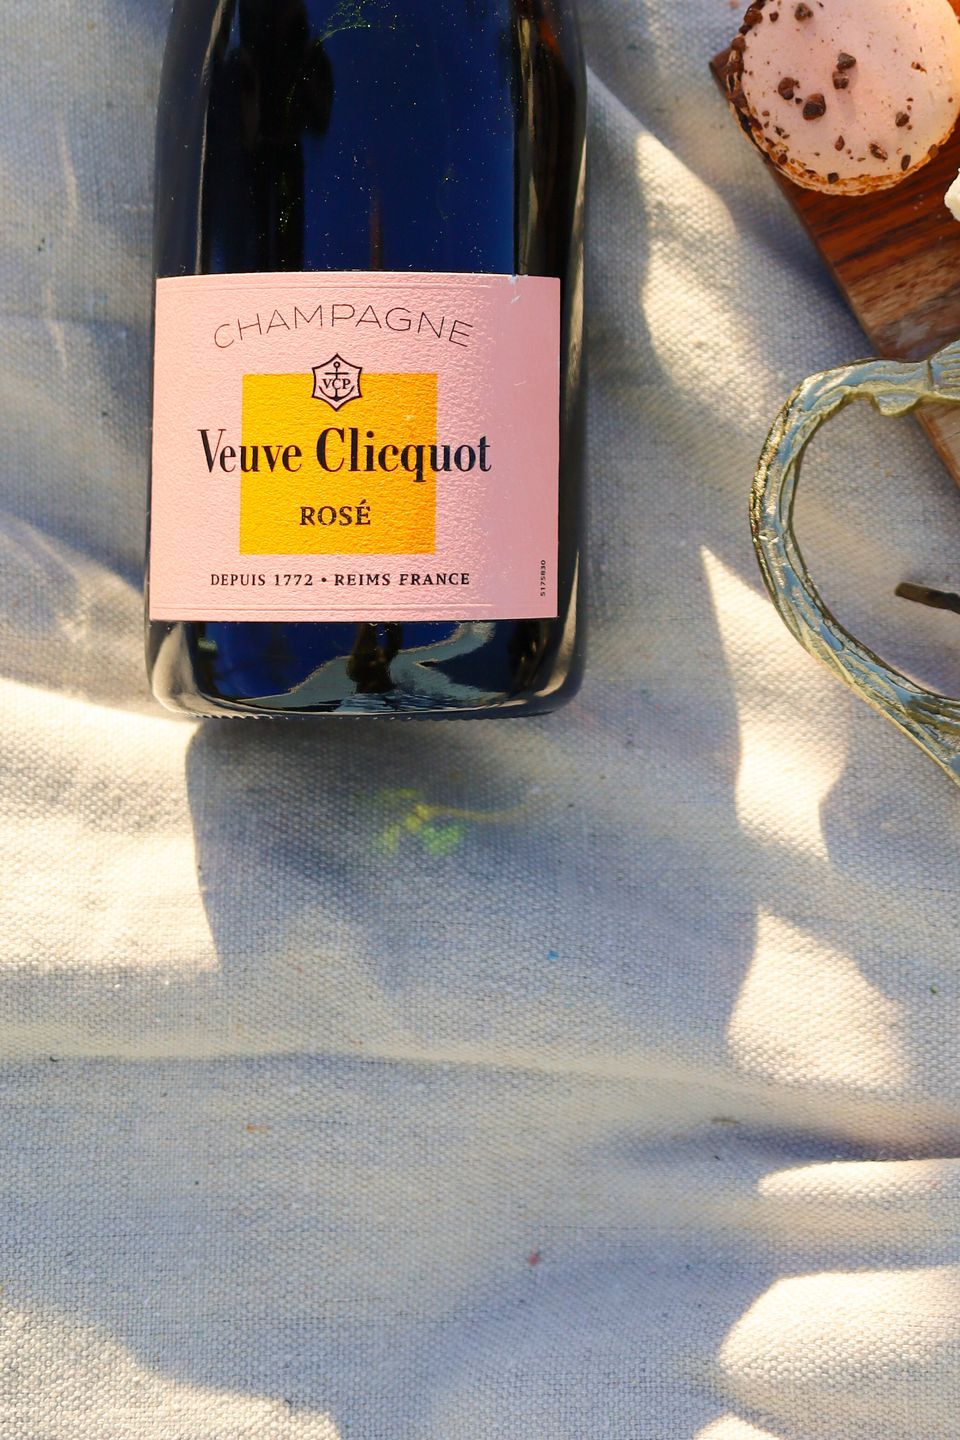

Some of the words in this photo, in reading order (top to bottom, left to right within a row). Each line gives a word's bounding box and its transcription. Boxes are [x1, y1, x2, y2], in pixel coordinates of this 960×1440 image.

[213, 303, 474, 349] CHAMPAGNE
[321, 377, 352, 390] VCP
[197, 428, 303, 473] Veuve
[315, 427, 492, 483] Clicquot
[299, 499, 372, 527] ROSÉ
[210, 573, 266, 587] DEPUIS
[273, 573, 314, 587] 1772
[333, 573, 391, 587] REIMS
[398, 572, 471, 587] FRANCE
